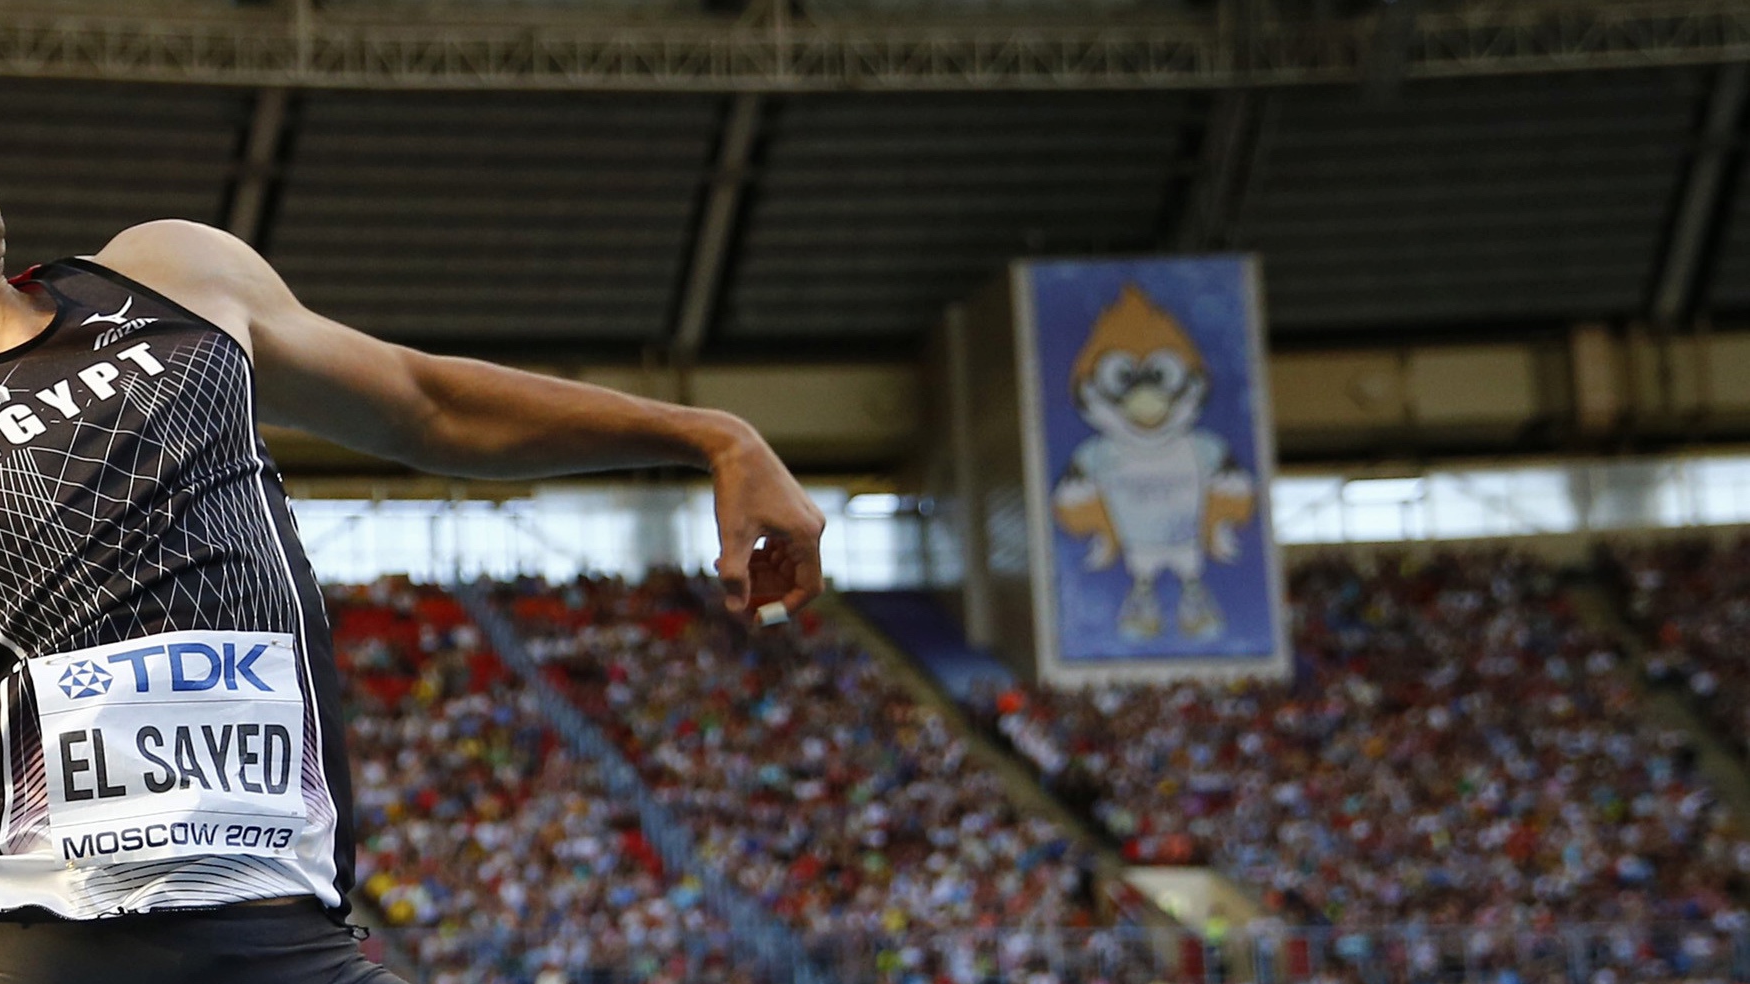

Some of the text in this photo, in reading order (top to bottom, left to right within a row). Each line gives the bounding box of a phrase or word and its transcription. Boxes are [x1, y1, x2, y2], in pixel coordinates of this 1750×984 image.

[107, 642, 275, 693] TDK
[59, 724, 292, 802] EL SAYED
[62, 822, 293, 860] MOSCOW 2013
